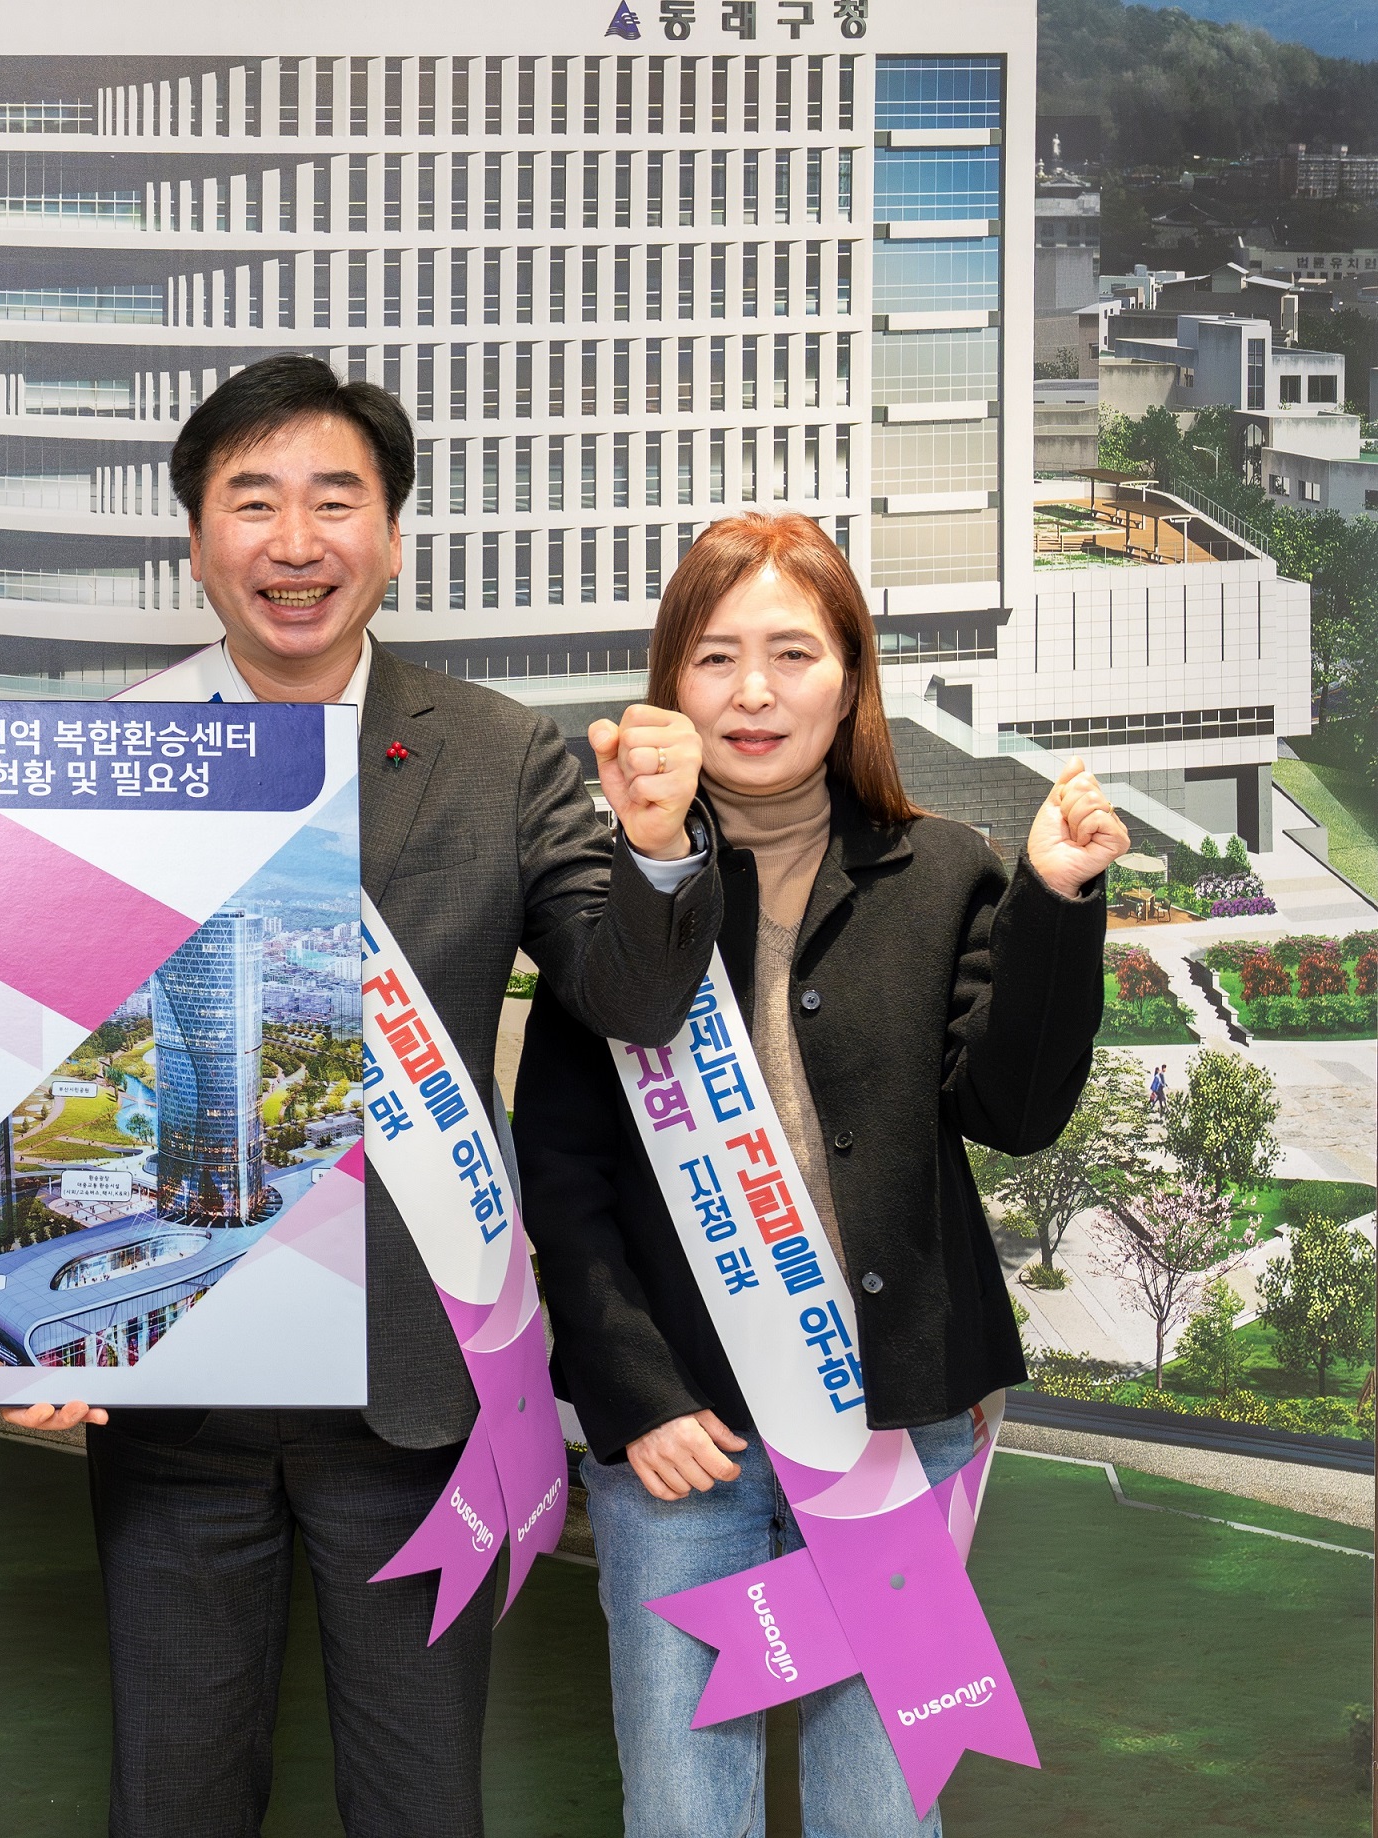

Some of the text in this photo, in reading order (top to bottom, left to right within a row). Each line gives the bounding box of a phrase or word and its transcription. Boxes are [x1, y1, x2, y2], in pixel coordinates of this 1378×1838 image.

[659, 0, 868, 40] 동래구청
[52, 719, 257, 758] 복합환승센터
[67, 762, 98, 796] 및
[110, 761, 210, 798] 필요성
[362, 968, 508, 1245] 건립을 위한
[368, 1089, 414, 1142] 및
[678, 1154, 738, 1244] 지정
[715, 1246, 760, 1296] 및
[725, 1127, 826, 1297] 건립을
[799, 1299, 866, 1414] 위한
[450, 1486, 494, 1552] busanjin
[517, 1477, 562, 1542] busanjin
[747, 1582, 799, 1683] busanjin
[897, 1676, 997, 1726] busanjin
